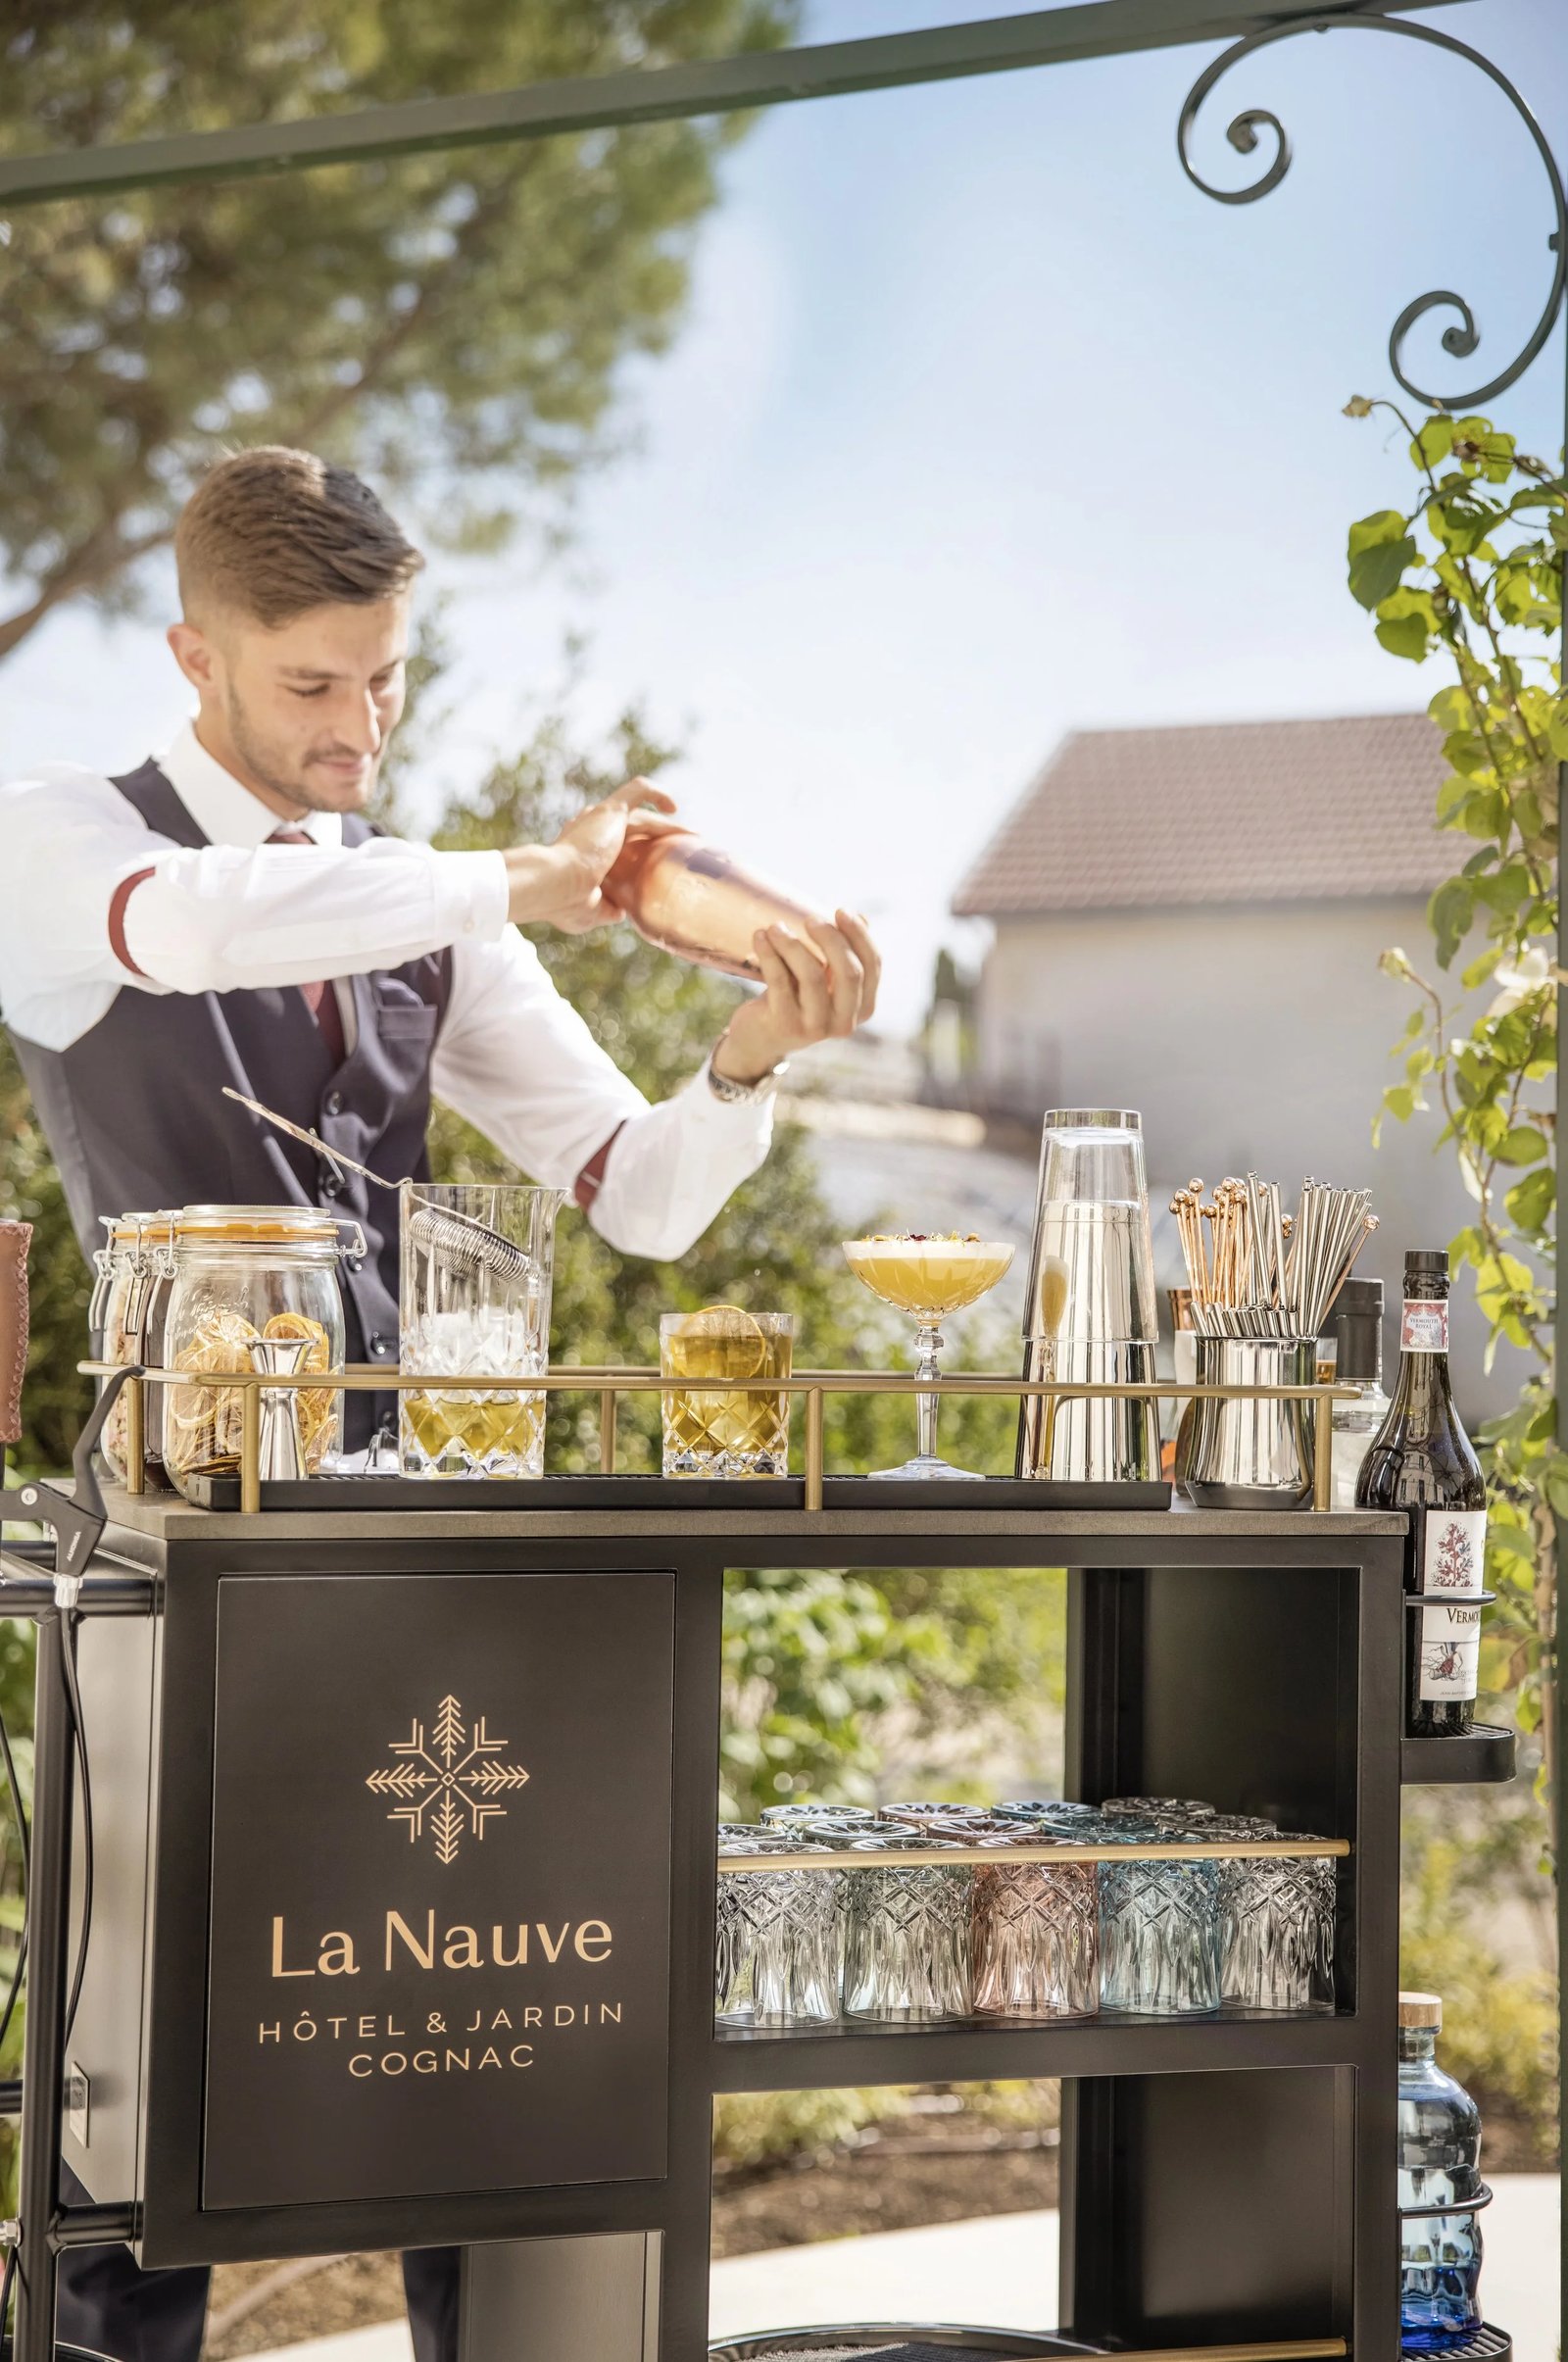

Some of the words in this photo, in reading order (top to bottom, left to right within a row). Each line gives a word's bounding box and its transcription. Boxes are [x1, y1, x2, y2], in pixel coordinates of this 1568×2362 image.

[1446, 1607, 1480, 1623] VERMO
[271, 1916, 361, 1978] La
[385, 1908, 612, 1972] Nauve
[259, 2010, 406, 2044] HÔTEL
[426, 2011, 448, 2034] &
[466, 2002, 622, 2032] JARDIN
[348, 2044, 535, 2078] COGNAC
